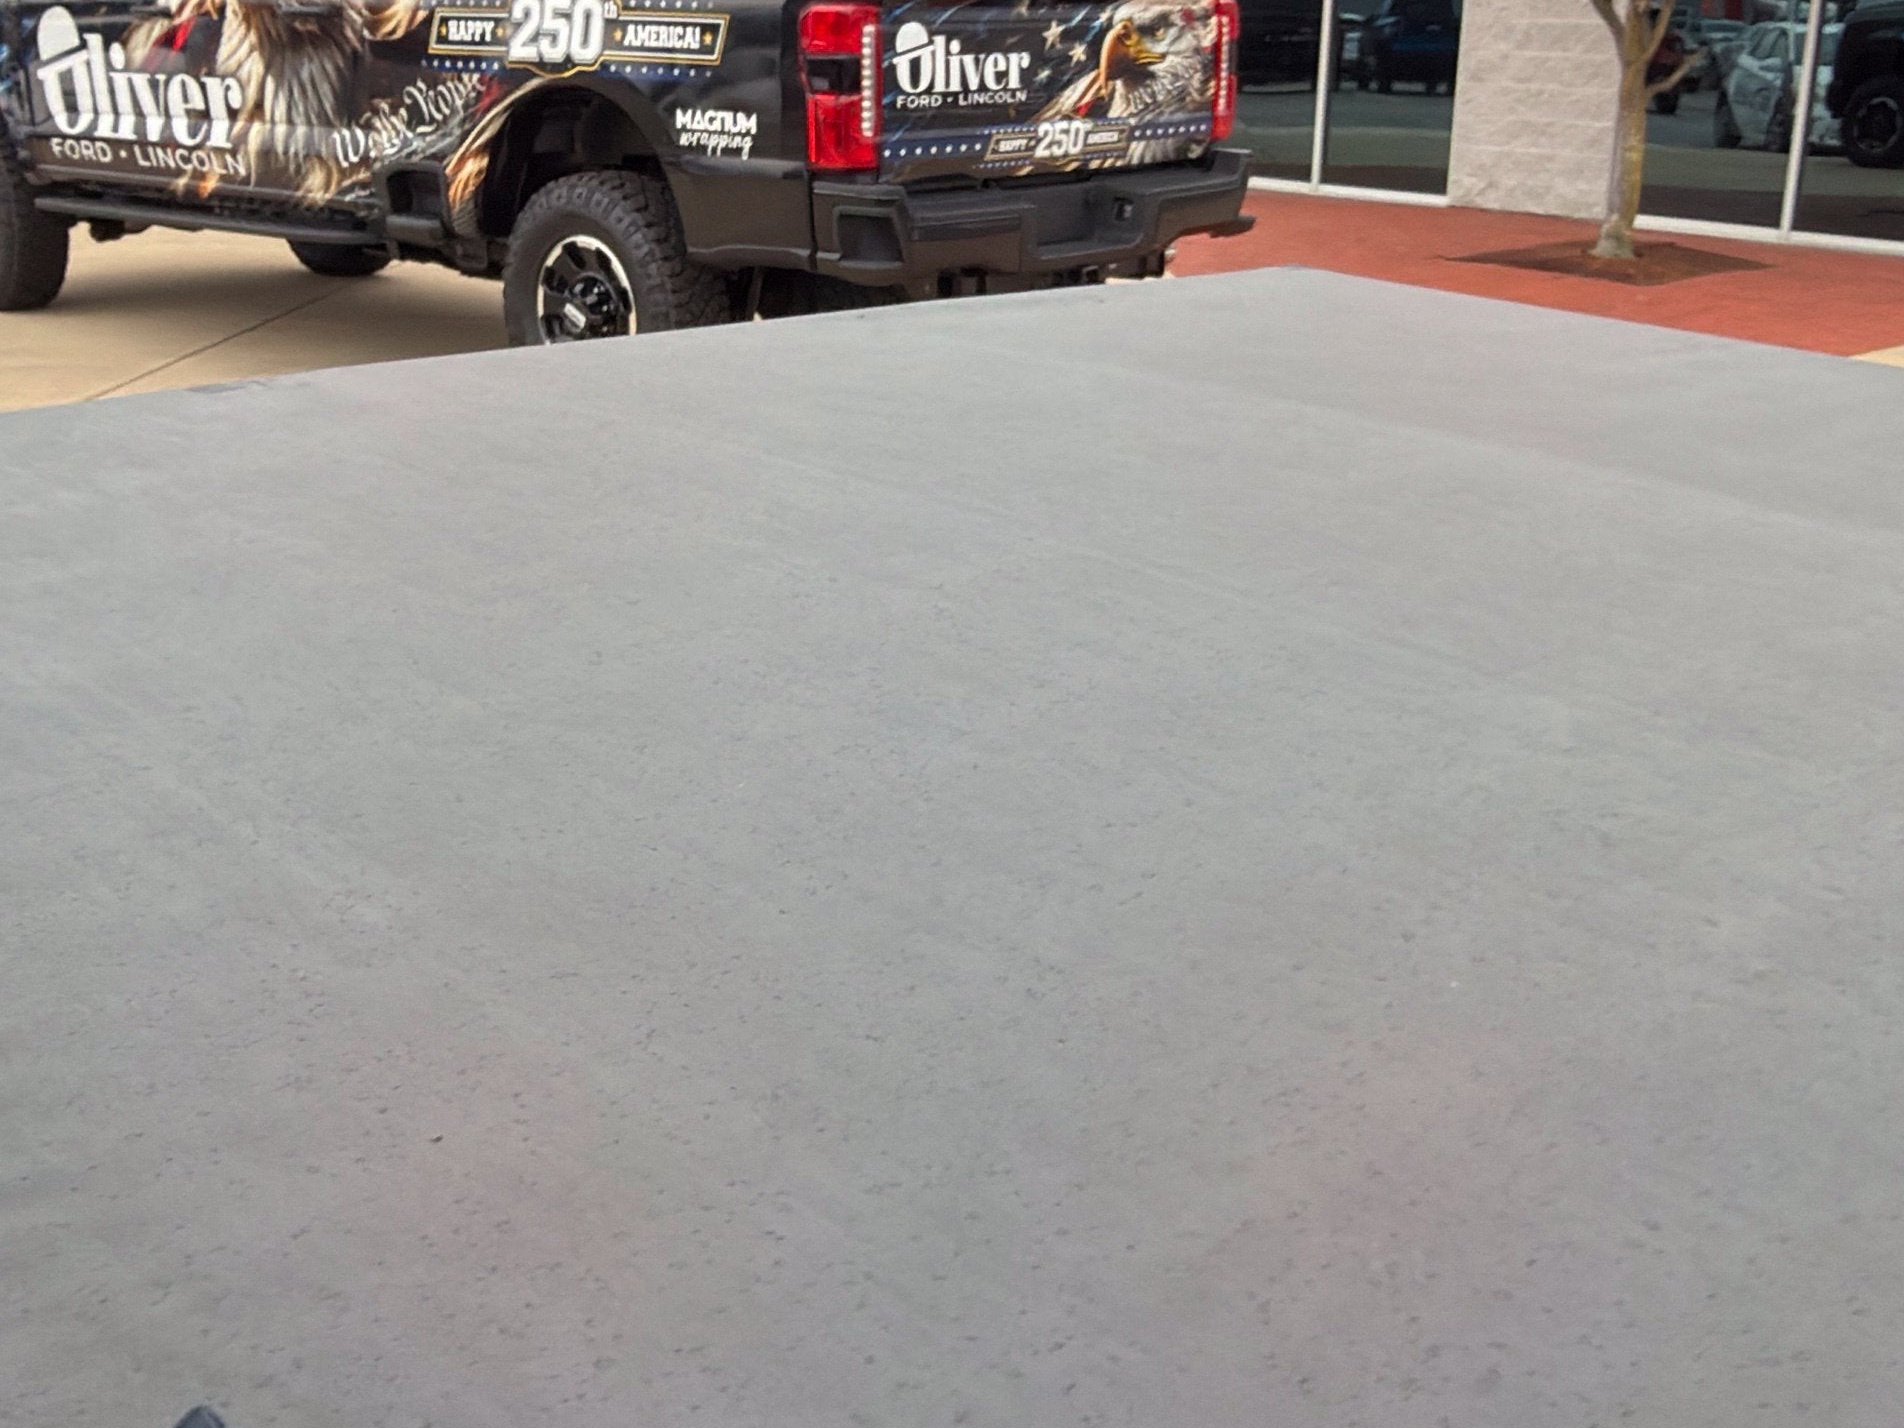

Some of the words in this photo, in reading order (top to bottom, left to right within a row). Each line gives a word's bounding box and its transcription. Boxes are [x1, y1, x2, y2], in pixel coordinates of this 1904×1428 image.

[447, 19, 495, 42] HAPPY
[623, 23, 701, 49] AMERICA!
[892, 20, 1031, 94] Oliver
[37, 5, 243, 149] Oliver
[896, 94, 944, 109] FORD
[958, 89, 1028, 107] LINCOLN
[51, 137, 113, 163] FORD
[133, 144, 246, 177] LINCOLN
[679, 131, 754, 161] wrapping
